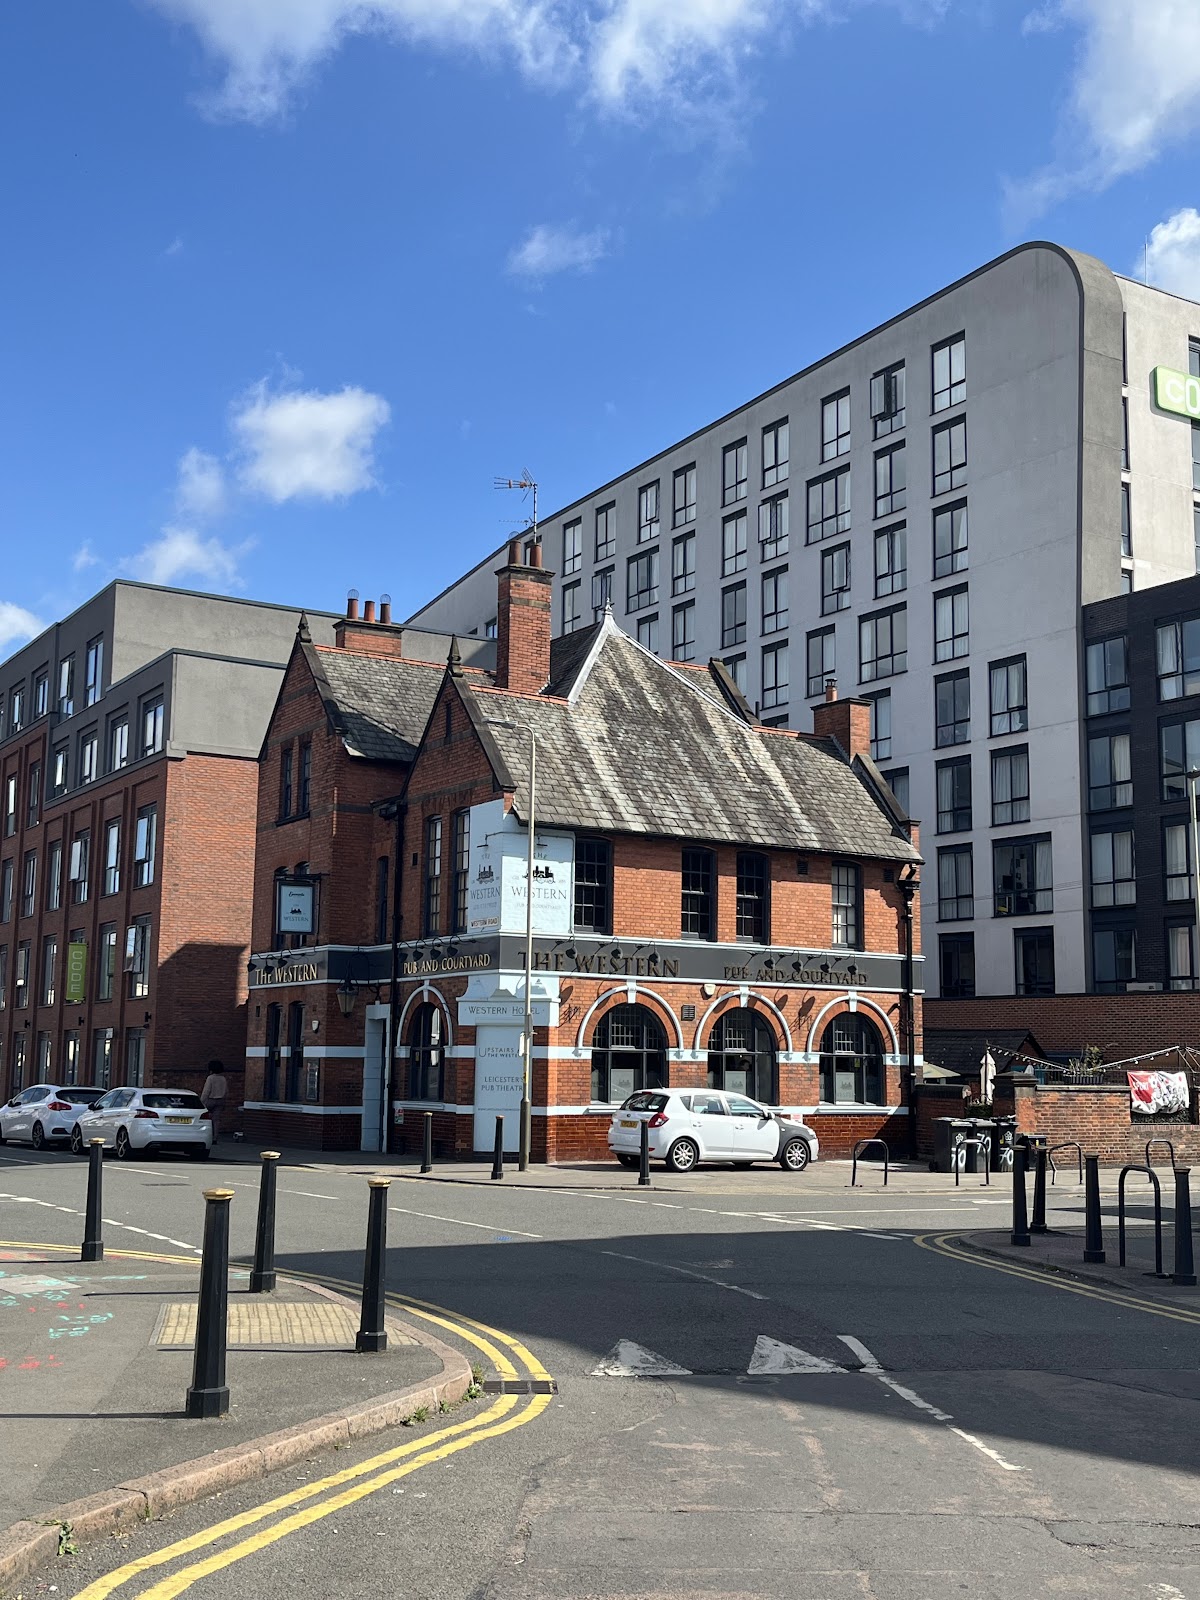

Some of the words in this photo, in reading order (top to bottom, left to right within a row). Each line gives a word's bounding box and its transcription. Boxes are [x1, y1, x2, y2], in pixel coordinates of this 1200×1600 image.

[470, 886, 500, 899] WESTERN
[511, 886, 567, 900] WESTERN
[471, 919, 487, 928] WESTERN
[488, 917, 498, 925] ROAD
[70, 951, 83, 993] CODE
[403, 961, 418, 974] PUB
[421, 960, 439, 973] AND
[442, 954, 491, 971] COURTYARD
[518, 951, 565, 971] THE
[574, 953, 681, 977] WESTERN
[255, 968, 272, 985] THE
[275, 963, 317, 983] WESTERN
[724, 966, 749, 979] PUB
[756, 969, 784, 982] AND
[791, 969, 868, 986] COURTYARD
[468, 1006, 507, 1015] WESTERN
[512, 1006, 540, 1015] HOEL
[479, 1047, 515, 1057] UPSTAIRS
[1000, 1147, 1014, 1166] 70
